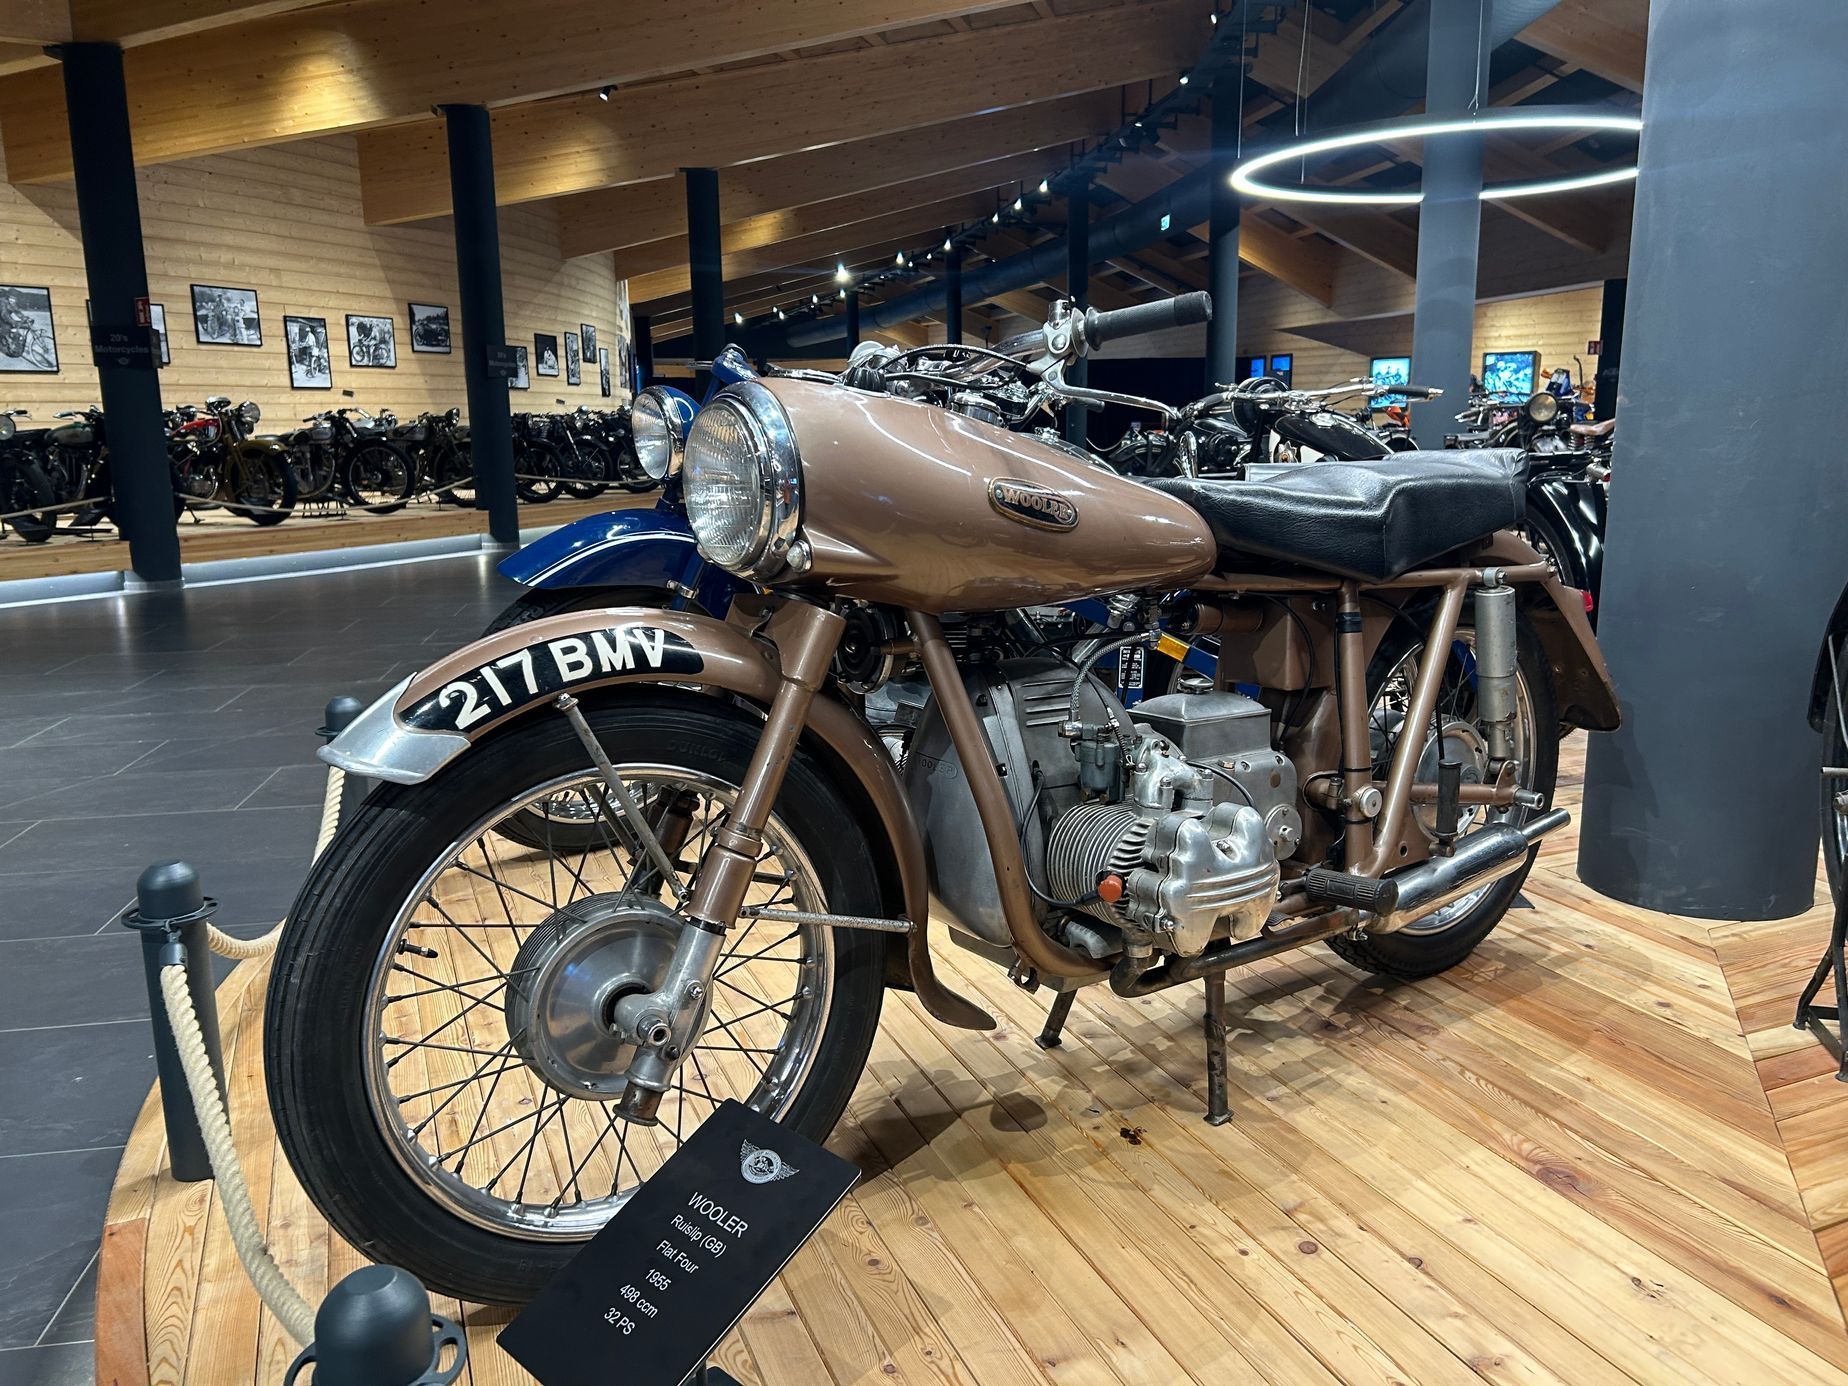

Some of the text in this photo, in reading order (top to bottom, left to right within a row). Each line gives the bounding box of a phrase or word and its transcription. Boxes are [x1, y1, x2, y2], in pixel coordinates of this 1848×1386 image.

[94, 344, 149, 354] Motorcycles
[438, 628, 665, 731] 217 BMV
[687, 1192, 749, 1239] WOOLER
[670, 1214, 727, 1258] Ruislip (GB)
[656, 1240, 699, 1274] Flat Four
[645, 1268, 672, 1291] 1955
[619, 1284, 659, 1319] 498 ccm
[603, 1307, 637, 1335] 32 PS
